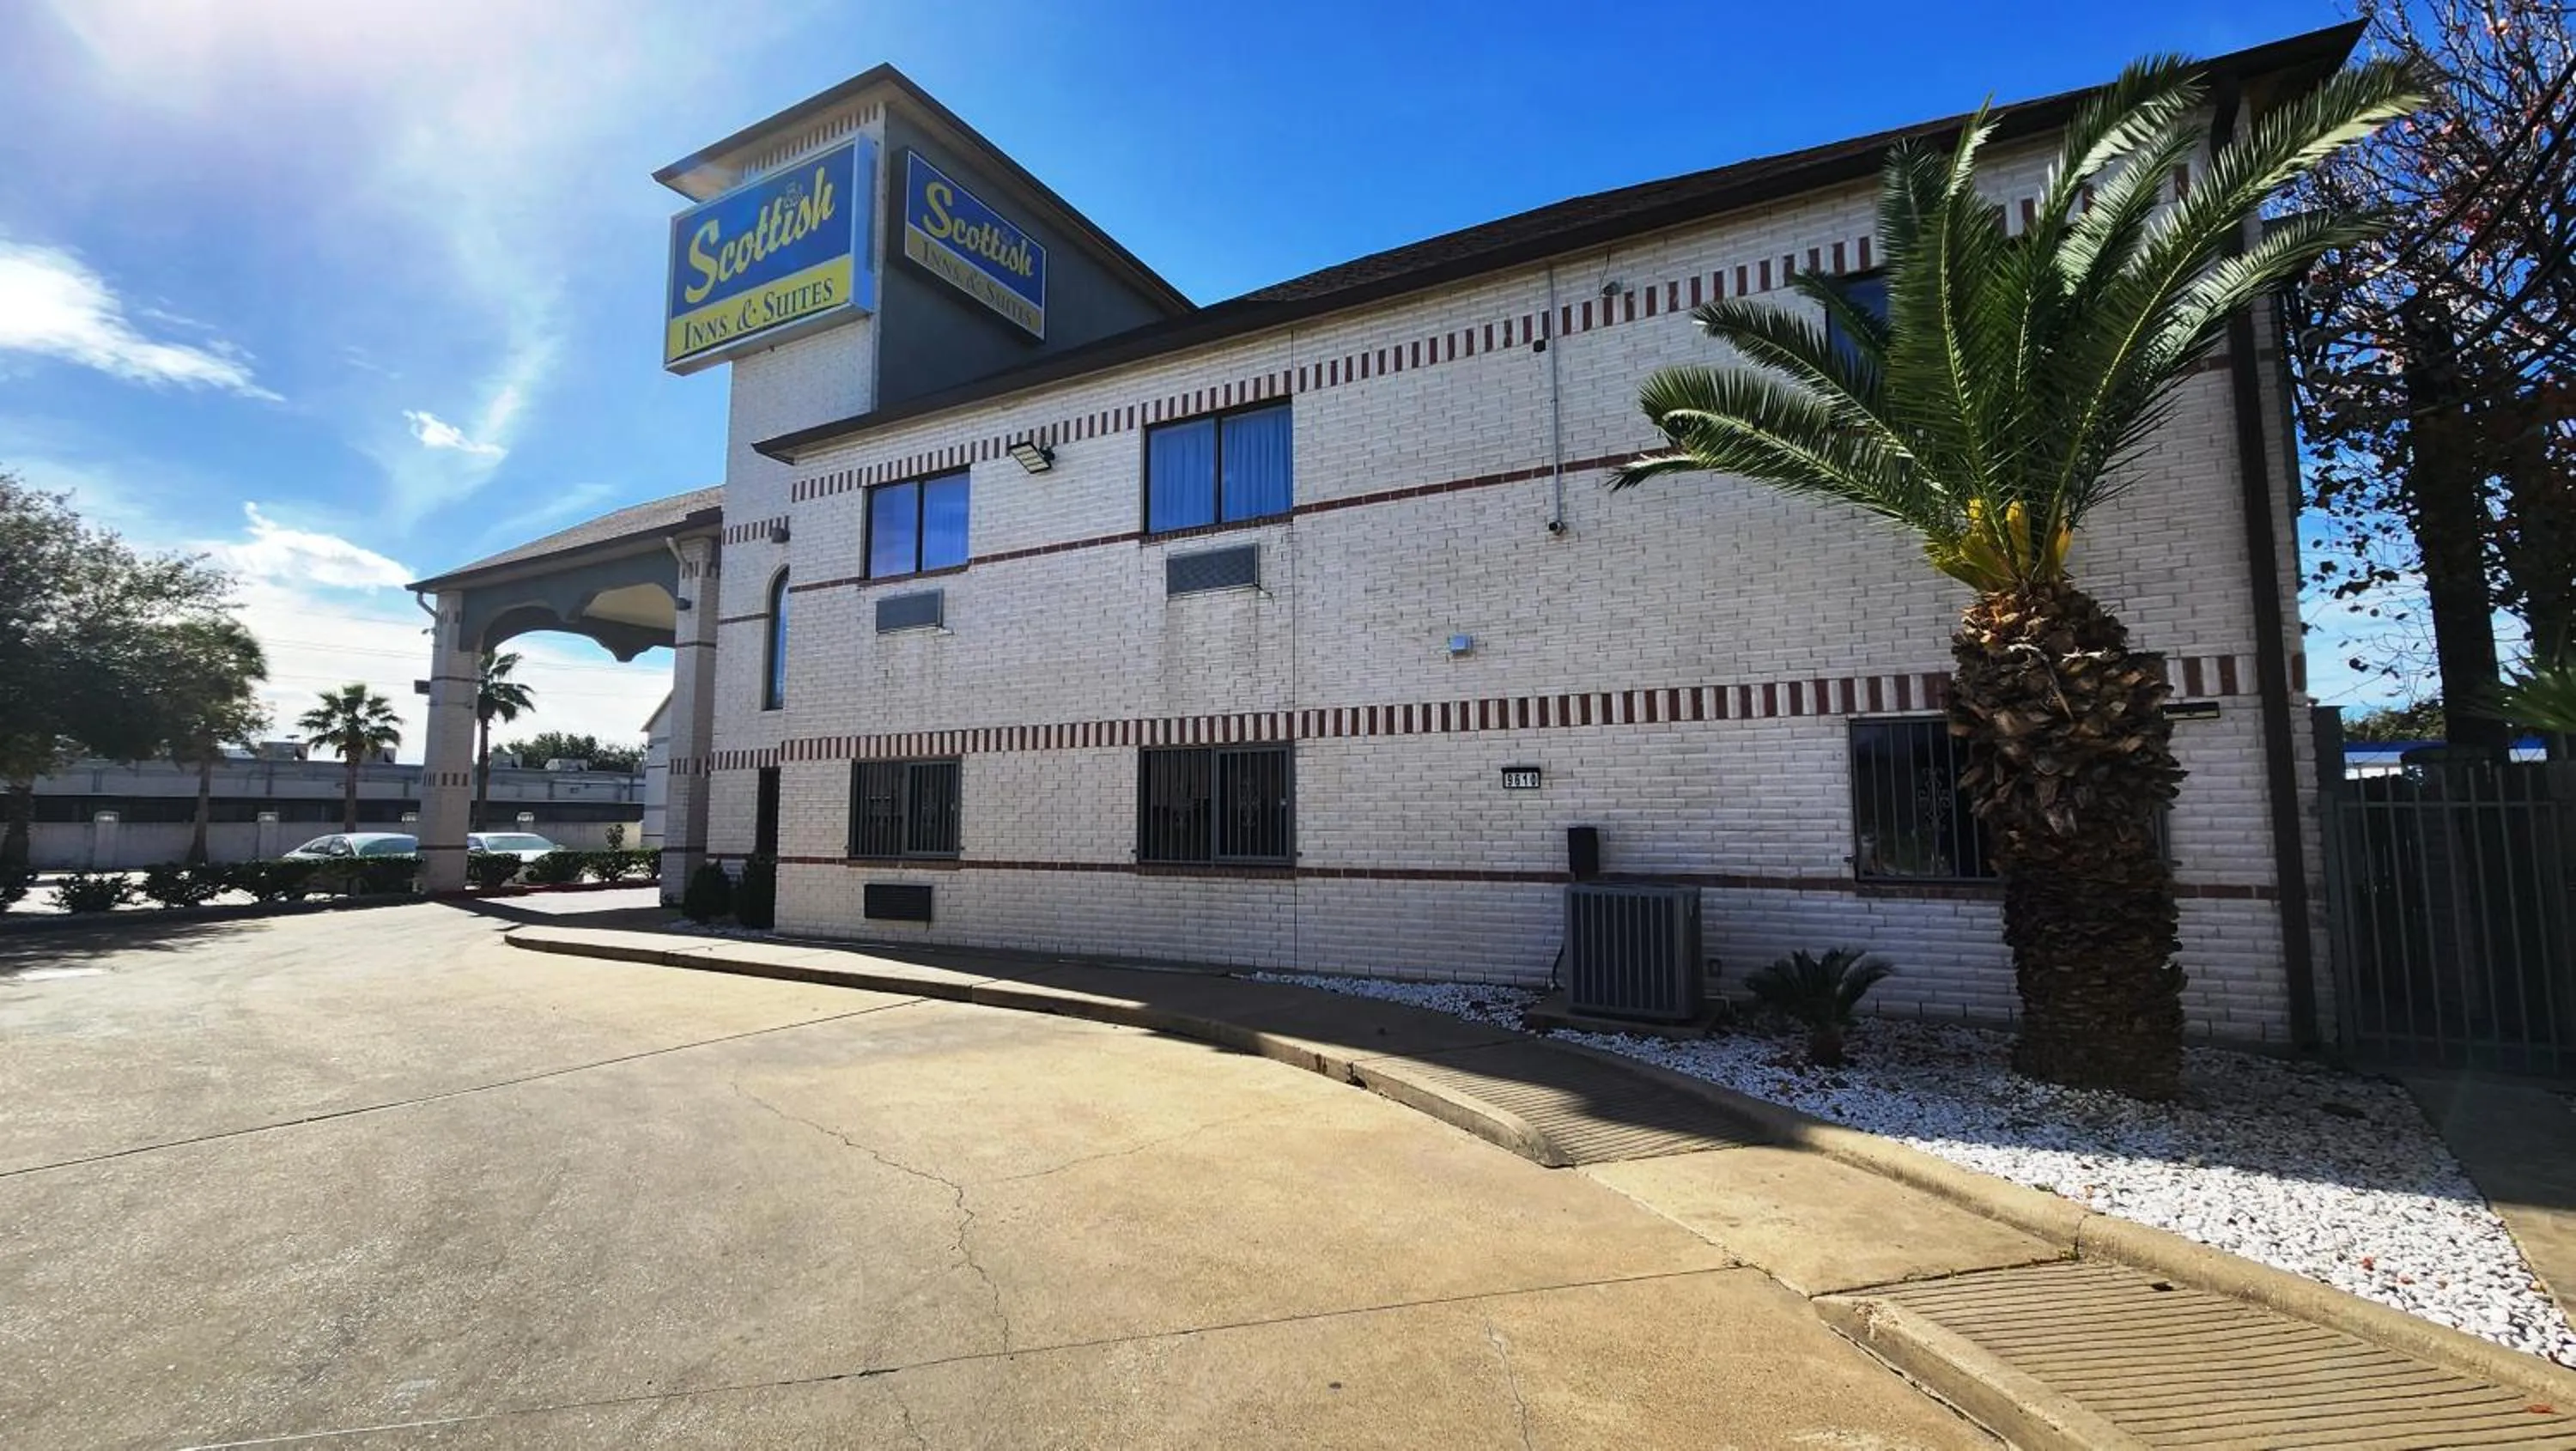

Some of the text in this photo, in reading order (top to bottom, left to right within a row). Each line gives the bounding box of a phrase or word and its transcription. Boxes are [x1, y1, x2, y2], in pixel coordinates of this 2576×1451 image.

[684, 167, 835, 303] Scottish
[923, 181, 1034, 277] Scottish
[683, 277, 834, 351] INNS & SUITES
[1507, 774, 1537, 786] 9610
